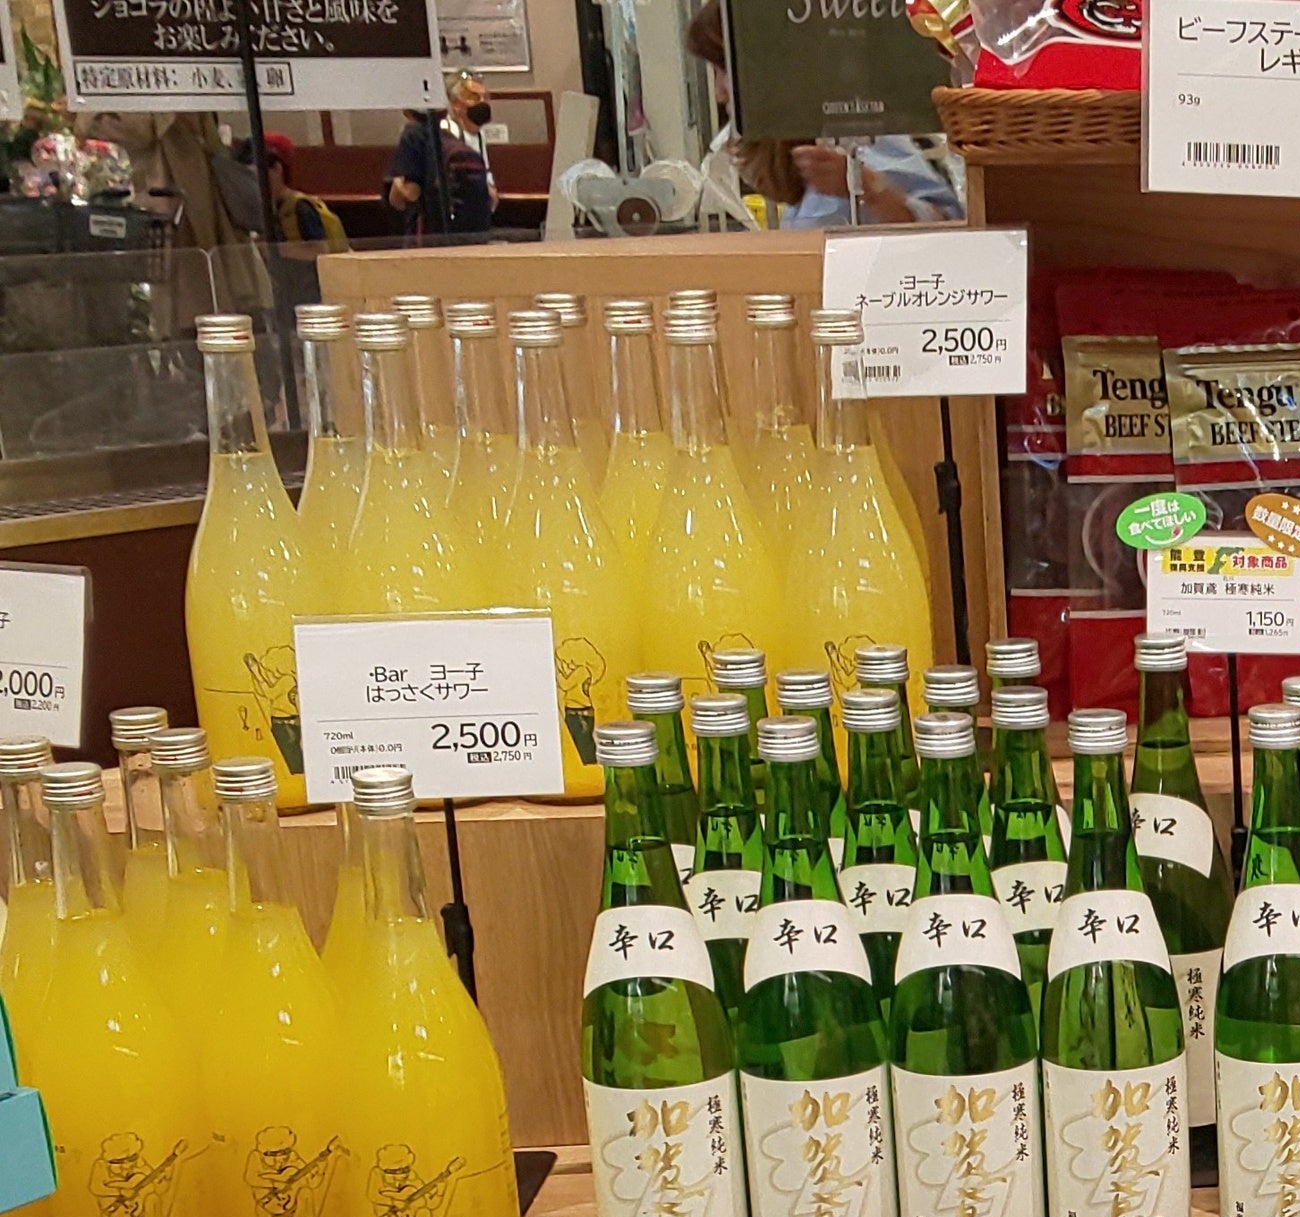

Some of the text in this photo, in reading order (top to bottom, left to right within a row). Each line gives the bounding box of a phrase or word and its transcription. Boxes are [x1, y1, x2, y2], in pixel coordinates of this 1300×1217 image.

[153, 22, 335, 51] お楽しみださい。
[1178, 93, 1201, 107] 93g
[855, 289, 1008, 310] ネーブルオレンジサワー
[1092, 368, 1168, 410] Teng
[1195, 377, 1299, 417] Tengu
[1104, 413, 1151, 438] BEEF
[1210, 421, 1258, 446] BEEF
[1134, 499, 1180, 517] 一度は
[1232, 555, 1288, 569] 対象商品
[429, 662, 485, 682] ヨー子
[366, 682, 489, 703] はっさくサワー
[323, 731, 354, 741] 720ml
[697, 886, 760, 922] 辛口
[849, 881, 912, 916] 辛口
[1005, 879, 1065, 914] 辛口
[608, 923, 675, 961] 辛口
[773, 917, 839, 956] 辛口
[922, 912, 988, 948] 辛口
[1078, 908, 1141, 944] 辛口
[1186, 967, 1206, 1039] 極寒純米
[865, 1085, 885, 1165] 極寒純米
[1011, 1081, 1030, 1162] 極寒純米
[1164, 1076, 1181, 1155] 極寒純米
[706, 1094, 729, 1176] 極寒純米
